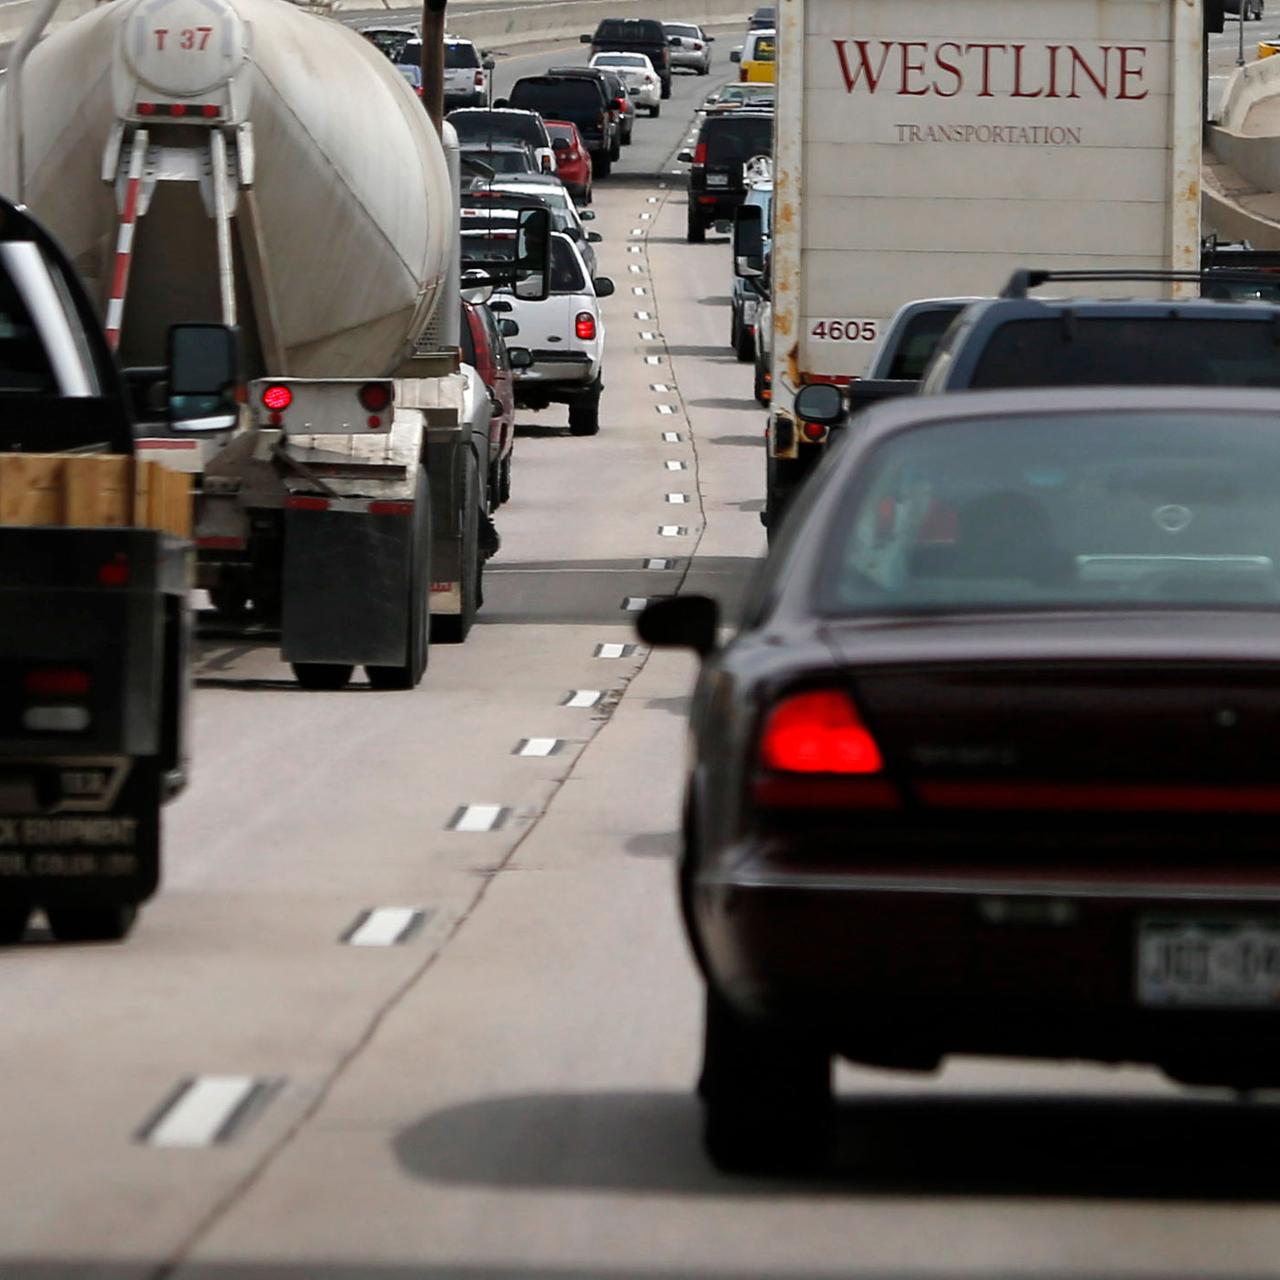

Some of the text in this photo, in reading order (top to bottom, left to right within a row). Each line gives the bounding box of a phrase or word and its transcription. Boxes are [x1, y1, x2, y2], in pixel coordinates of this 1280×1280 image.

[154, 26, 213, 51] T 37
[832, 40, 1149, 100] WESTLINE
[893, 124, 1083, 145] TRANSPORTATION
[812, 320, 876, 341] 4605
